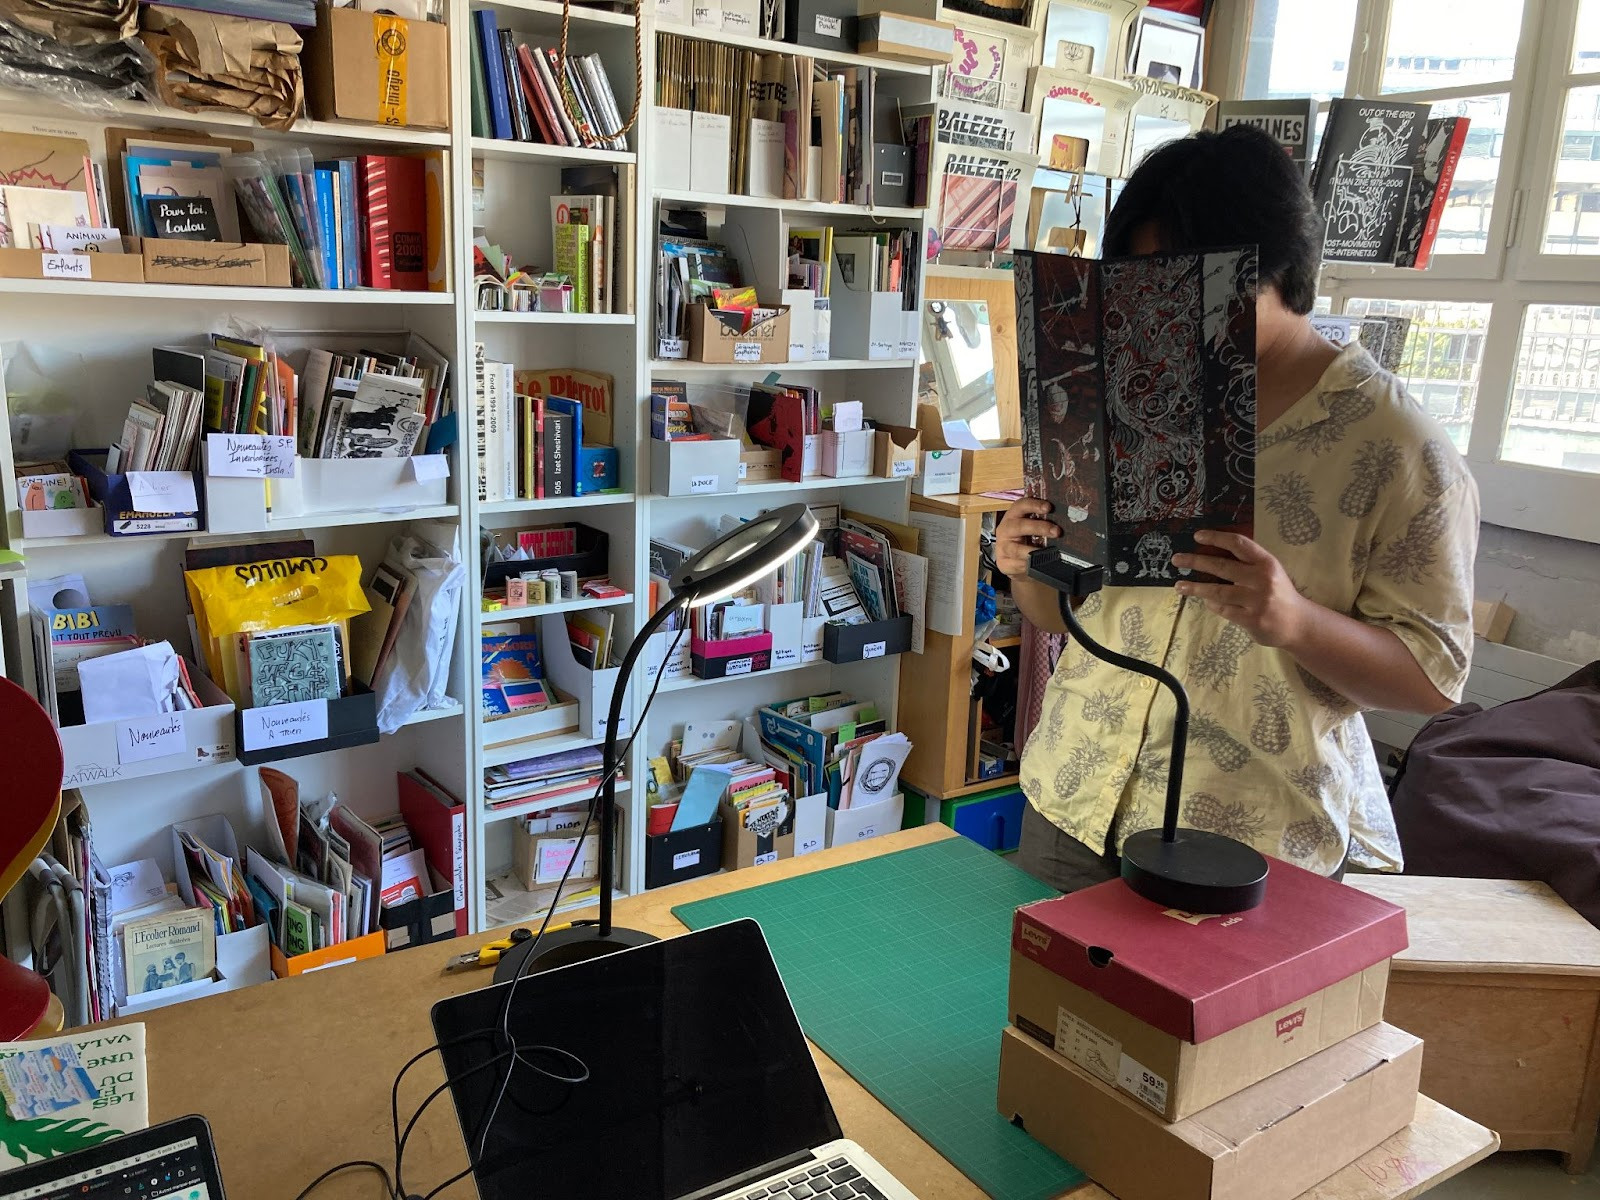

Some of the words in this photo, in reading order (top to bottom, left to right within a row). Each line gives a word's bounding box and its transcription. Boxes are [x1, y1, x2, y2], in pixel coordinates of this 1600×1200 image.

[1359, 108, 1373, 117] OUT
[1375, 108, 1385, 117] OF
[1386, 109, 1398, 118] THE
[1398, 110, 1416, 119] GRID
[938, 109, 1004, 139] BALEZE
[1225, 118, 1302, 142] INES
[944, 153, 1009, 180] BALEZE
[1005, 168, 1021, 181] #2
[1329, 177, 1352, 186] ITALIAN
[1353, 178, 1369, 187] ZINE
[165, 221, 206, 234] Loulou
[47, 261, 83, 273] Enfants
[549, 375, 606, 413] Pierrot
[553, 420, 561, 459] Sheshivari
[554, 480, 562, 495] 505
[53, 610, 101, 630] BIBI
[68, 632, 90, 641] TOUT
[261, 710, 311, 730] Nouveautés
[129, 718, 181, 747] Nouveautés
[63, 767, 121, 786] CATWALK
[168, 921, 200, 937] Romand
[87, 1051, 134, 1069] UNE
[100, 1072, 133, 1087] DU
[92, 1092, 135, 1110] LES
